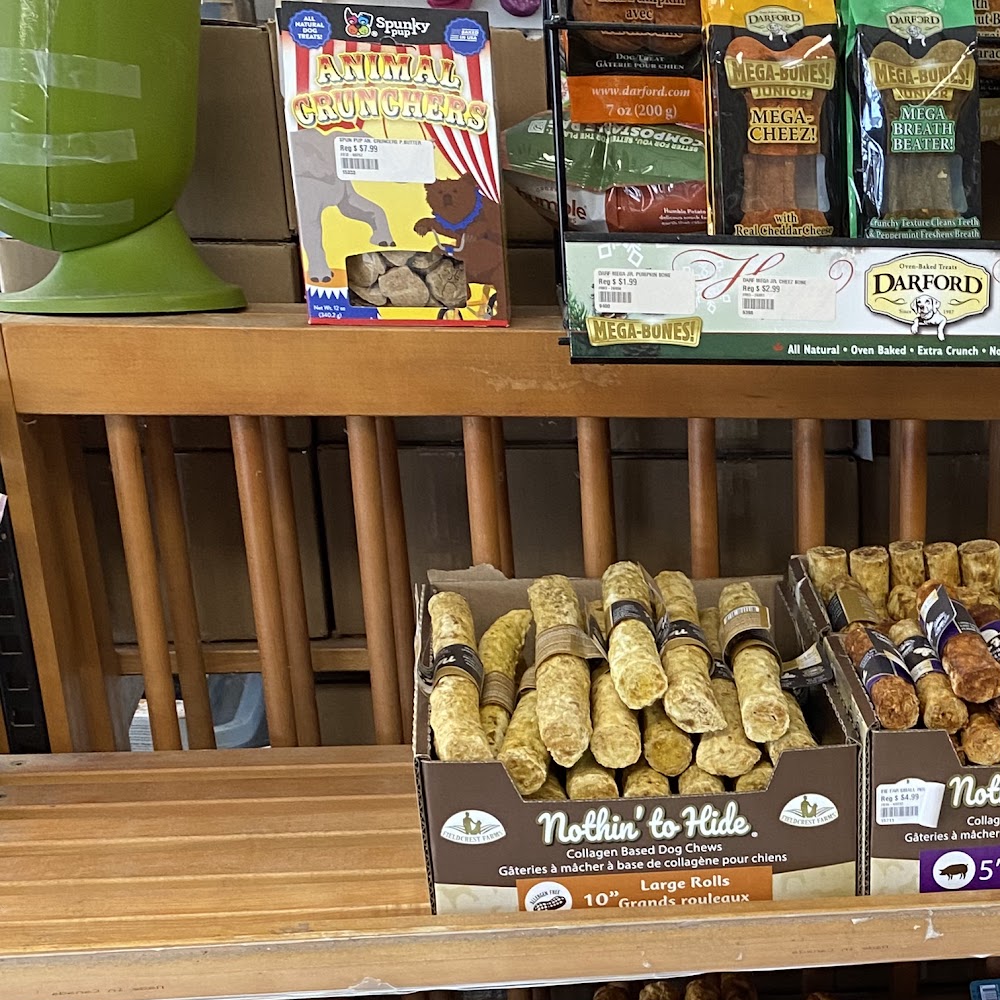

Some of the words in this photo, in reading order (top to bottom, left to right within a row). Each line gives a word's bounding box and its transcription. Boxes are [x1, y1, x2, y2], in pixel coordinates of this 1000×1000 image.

[748, 15, 801, 24] DARFORD
[889, 15, 940, 24] DARFORD
[376, 17, 430, 38] Spunky
[391, 29, 410, 38] pup
[316, 53, 461, 90] ANIMAL
[592, 85, 691, 98] www.darford.com
[756, 87, 809, 98] JUNIOR
[293, 87, 489, 134] CRUNCHERS
[606, 105, 613, 116] 7
[617, 107, 631, 116] oz
[634, 104, 662, 118] (200
[665, 105, 677, 119] g)
[752, 109, 813, 124] MEGA-
[901, 107, 945, 120] MEGA
[749, 126, 816, 141] CHEEZ!
[893, 122, 953, 135] BREATH
[340, 145, 352, 153] Reg
[353, 144, 358, 152] $
[359, 145, 378, 153] $7.99
[893, 137, 954, 150] BEATER!
[774, 212, 798, 223] with
[735, 226, 758, 236] Real
[760, 224, 802, 236] Cheddar
[899, 263, 937, 271] Oven-Baked
[619, 278, 637, 286] $1.99
[873, 273, 983, 295] DARFORD
[593, 320, 695, 343] MEGA-BONES!
[788, 344, 801, 355] All
[804, 345, 840, 355] Natural
[851, 345, 874, 355] Oven
[878, 345, 906, 356] Baked
[917, 345, 942, 356] Extra
[946, 345, 979, 356] Crunch
[537, 805, 644, 845] Nothin'
[648, 806, 681, 839] to
[681, 801, 751, 838] Hide
[566, 849, 618, 859] Collagen
[621, 846, 656, 856] Based
[658, 844, 682, 855] Dog
[685, 843, 723, 853] Chews
[498, 866, 548, 876] Gâteries
[550, 864, 557, 873] à
[561, 862, 604, 873] mâcher
[607, 861, 613, 870] à
[617, 860, 644, 870] base
[646, 859, 662, 868] de
[664, 857, 719, 868] collagène
[722, 855, 748, 866] pour
[751, 853, 788, 863] chiens
[641, 879, 685, 892] Large
[690, 875, 730, 888] Rolls
[618, 896, 676, 907] Grands
[681, 893, 750, 905] rouleaux
